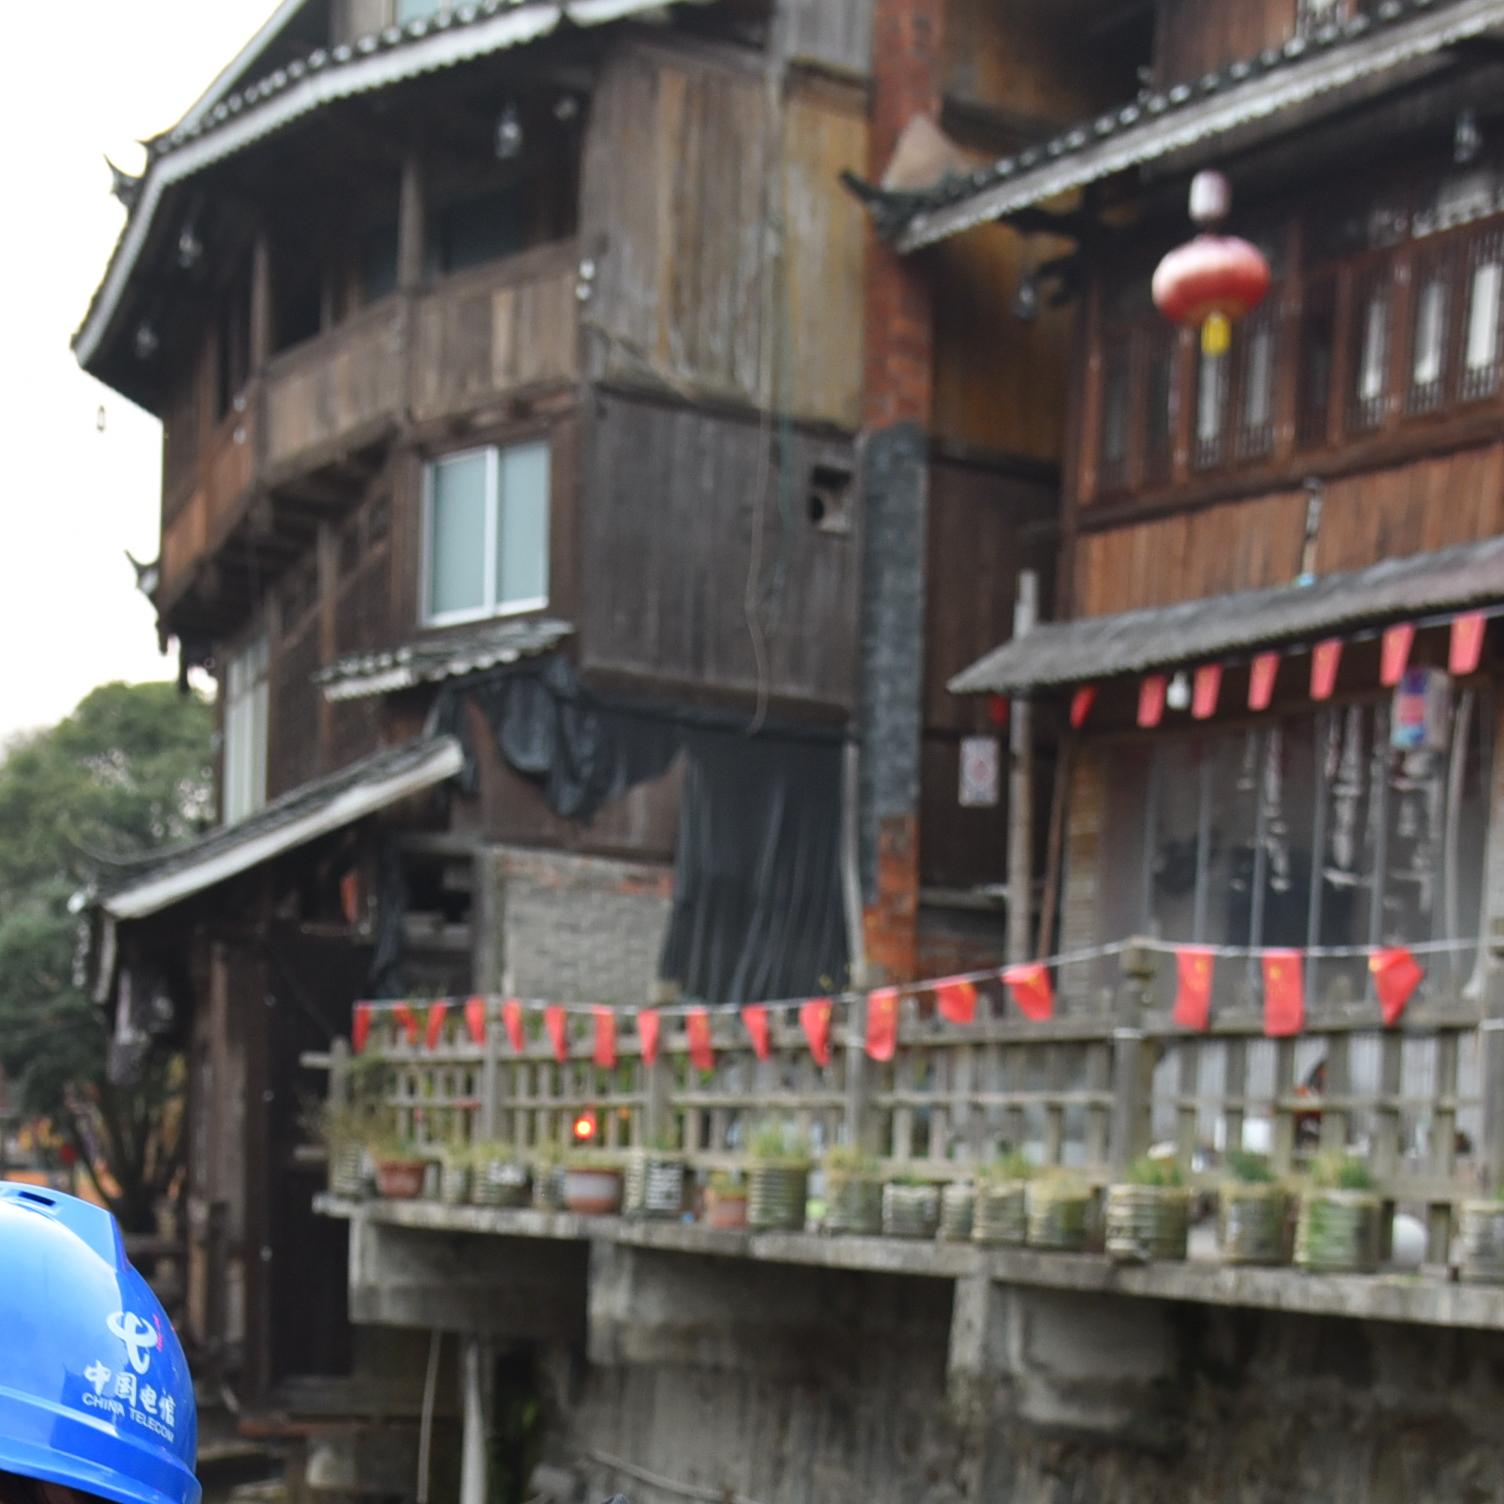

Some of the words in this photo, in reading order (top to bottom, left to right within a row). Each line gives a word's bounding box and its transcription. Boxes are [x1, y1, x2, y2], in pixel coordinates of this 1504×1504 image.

[81, 1392, 126, 1417] CHINA
[128, 1406, 176, 1443] TELECOM
[83, 1359, 176, 1428] 中国电信
